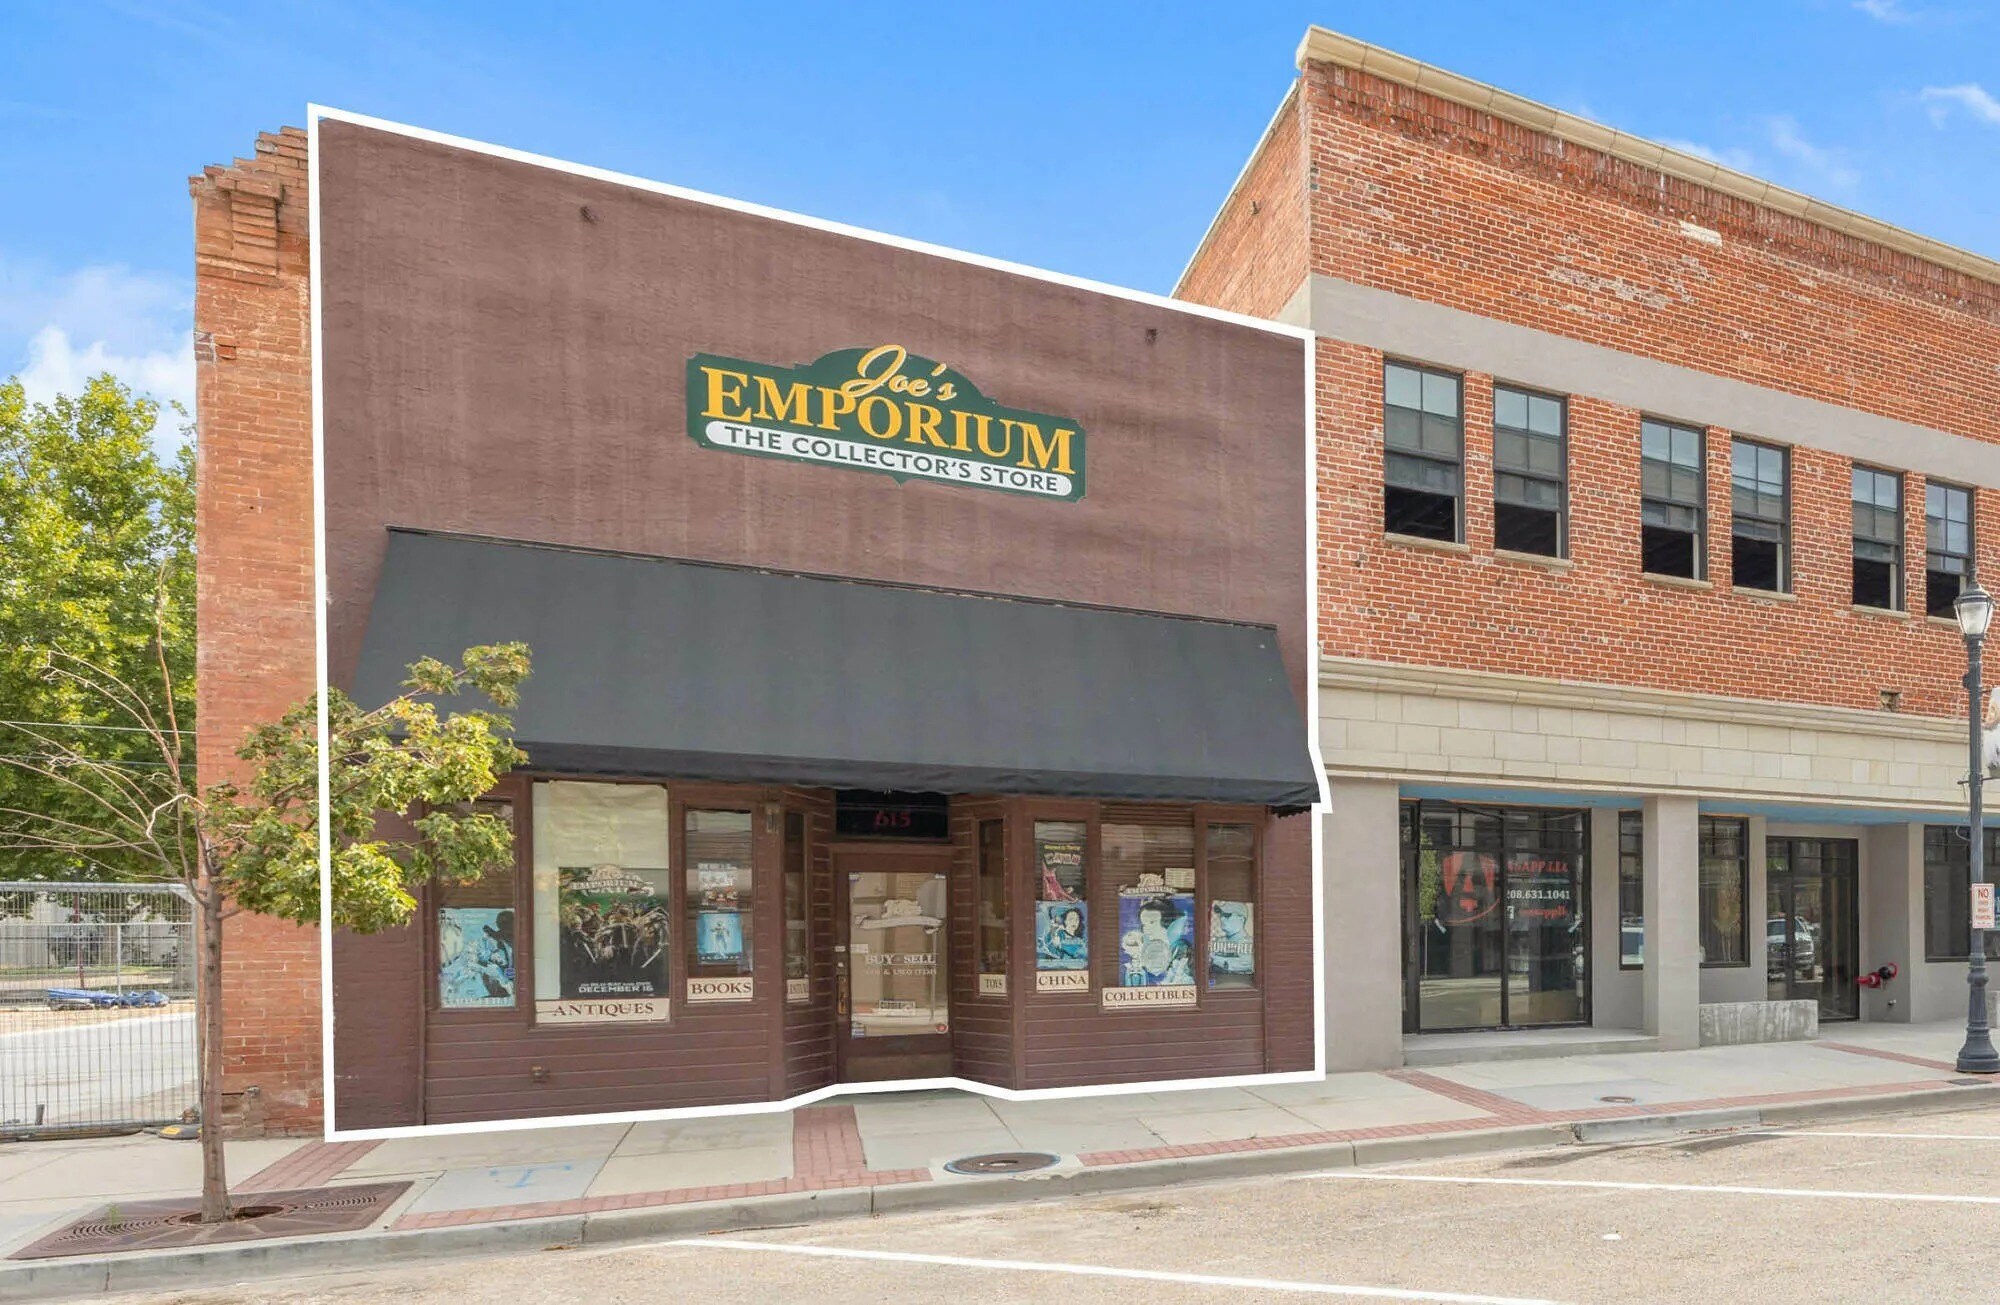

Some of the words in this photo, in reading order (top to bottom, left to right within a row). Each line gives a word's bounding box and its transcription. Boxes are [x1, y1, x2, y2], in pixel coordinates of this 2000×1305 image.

[841, 344, 958, 401] Joe's
[700, 366, 1076, 475] EMPORIUM
[724, 425, 782, 451] THE
[791, 436, 972, 480] COLLECTOR'S
[980, 465, 1059, 493] STORE
[865, 953, 894, 965] BUY
[903, 953, 937, 965] SELL
[1038, 975, 1087, 986] CHINA
[578, 985, 640, 993] DECEMBER
[691, 982, 752, 995] BOOKS
[1104, 989, 1196, 1002] COLLECTIBLES
[552, 1002, 655, 1017] ANTIQUES
